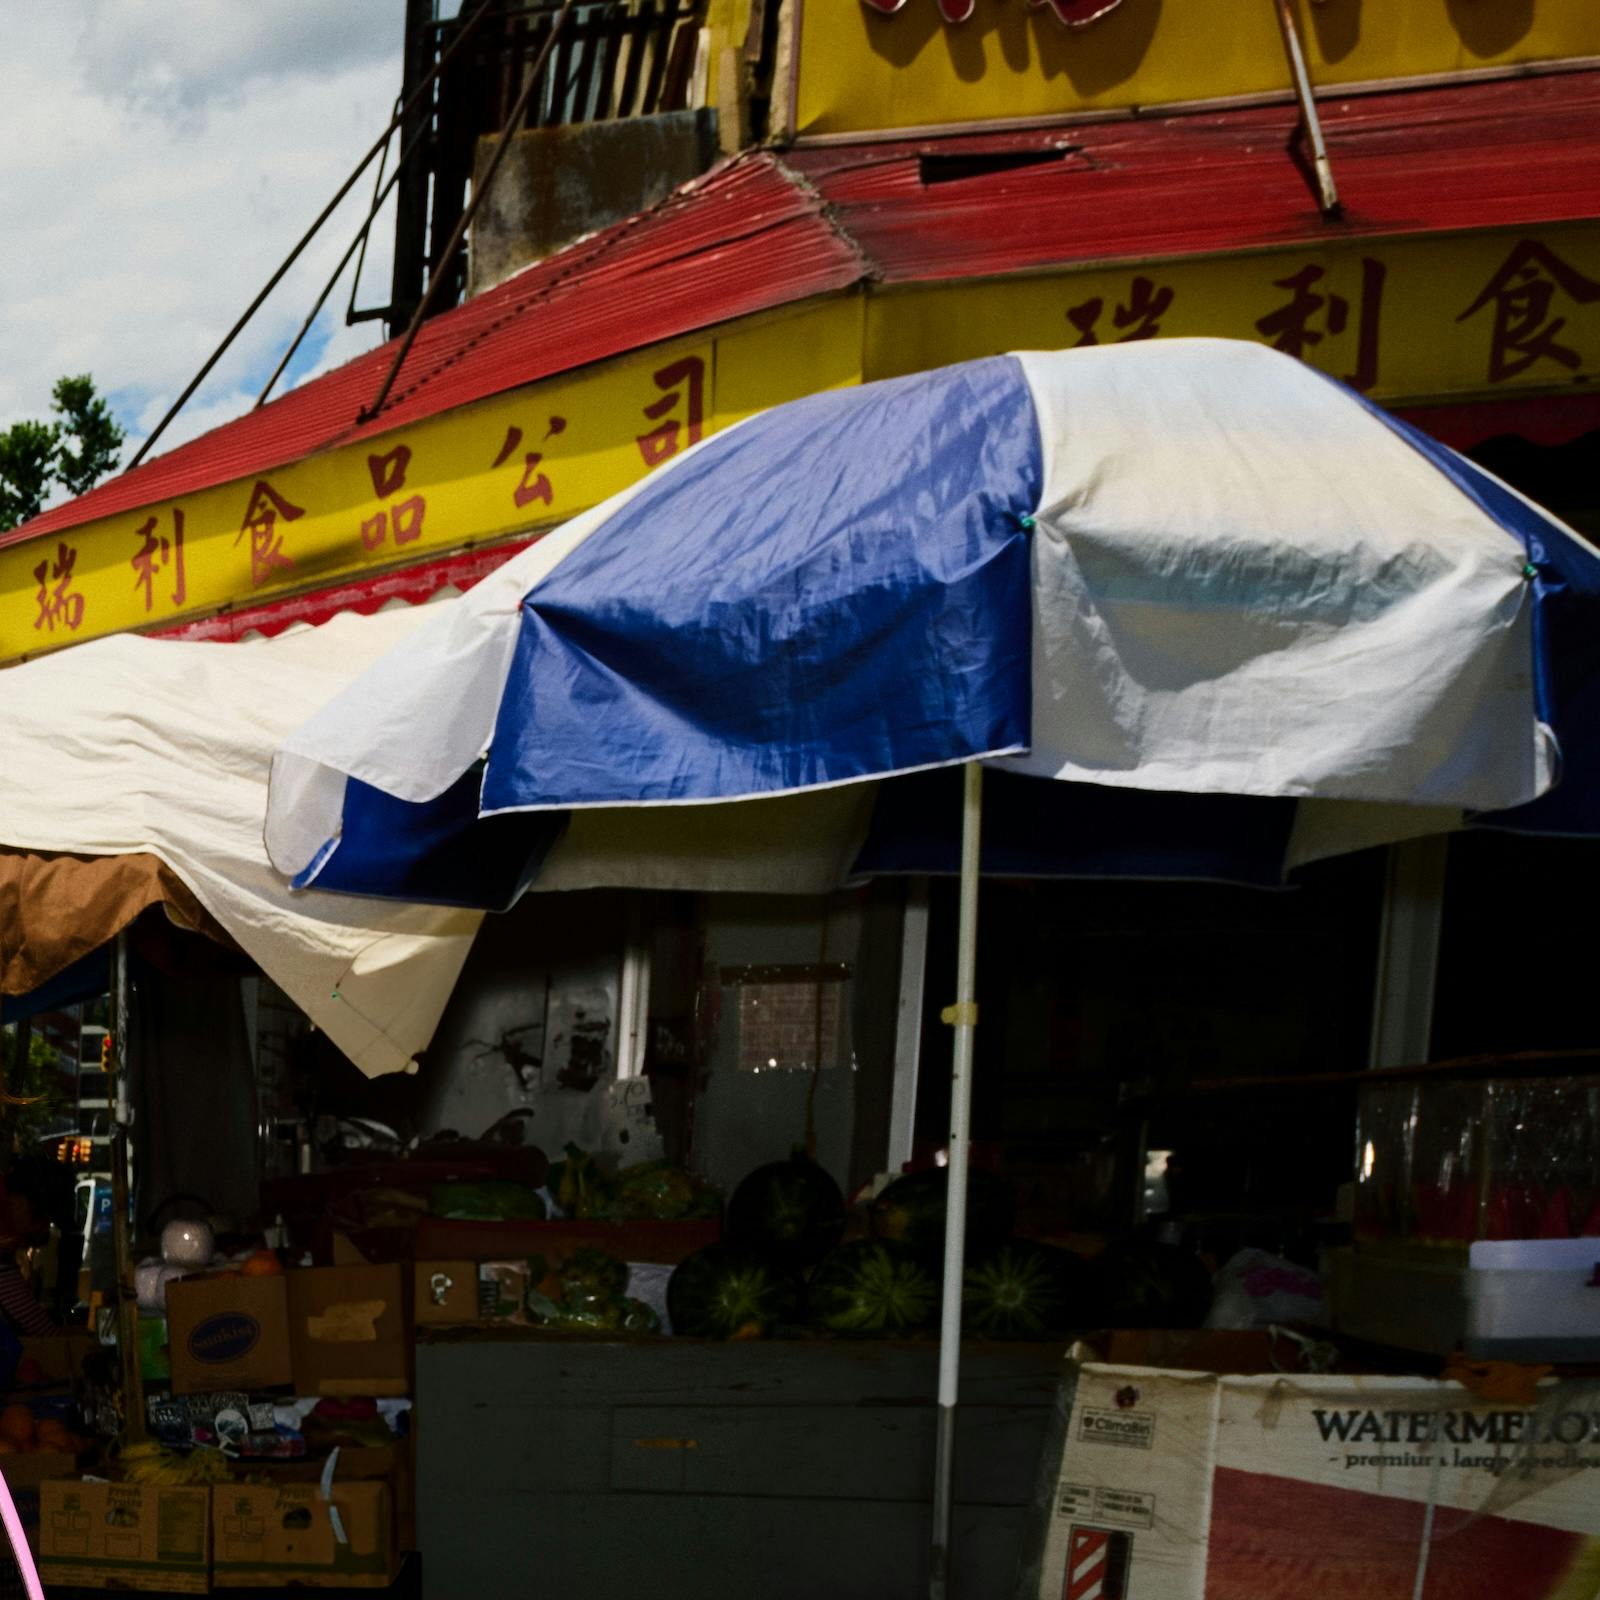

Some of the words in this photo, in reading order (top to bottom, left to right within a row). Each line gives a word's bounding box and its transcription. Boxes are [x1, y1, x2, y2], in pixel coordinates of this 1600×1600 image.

[32, 356, 705, 632] 瑞利食品公司
